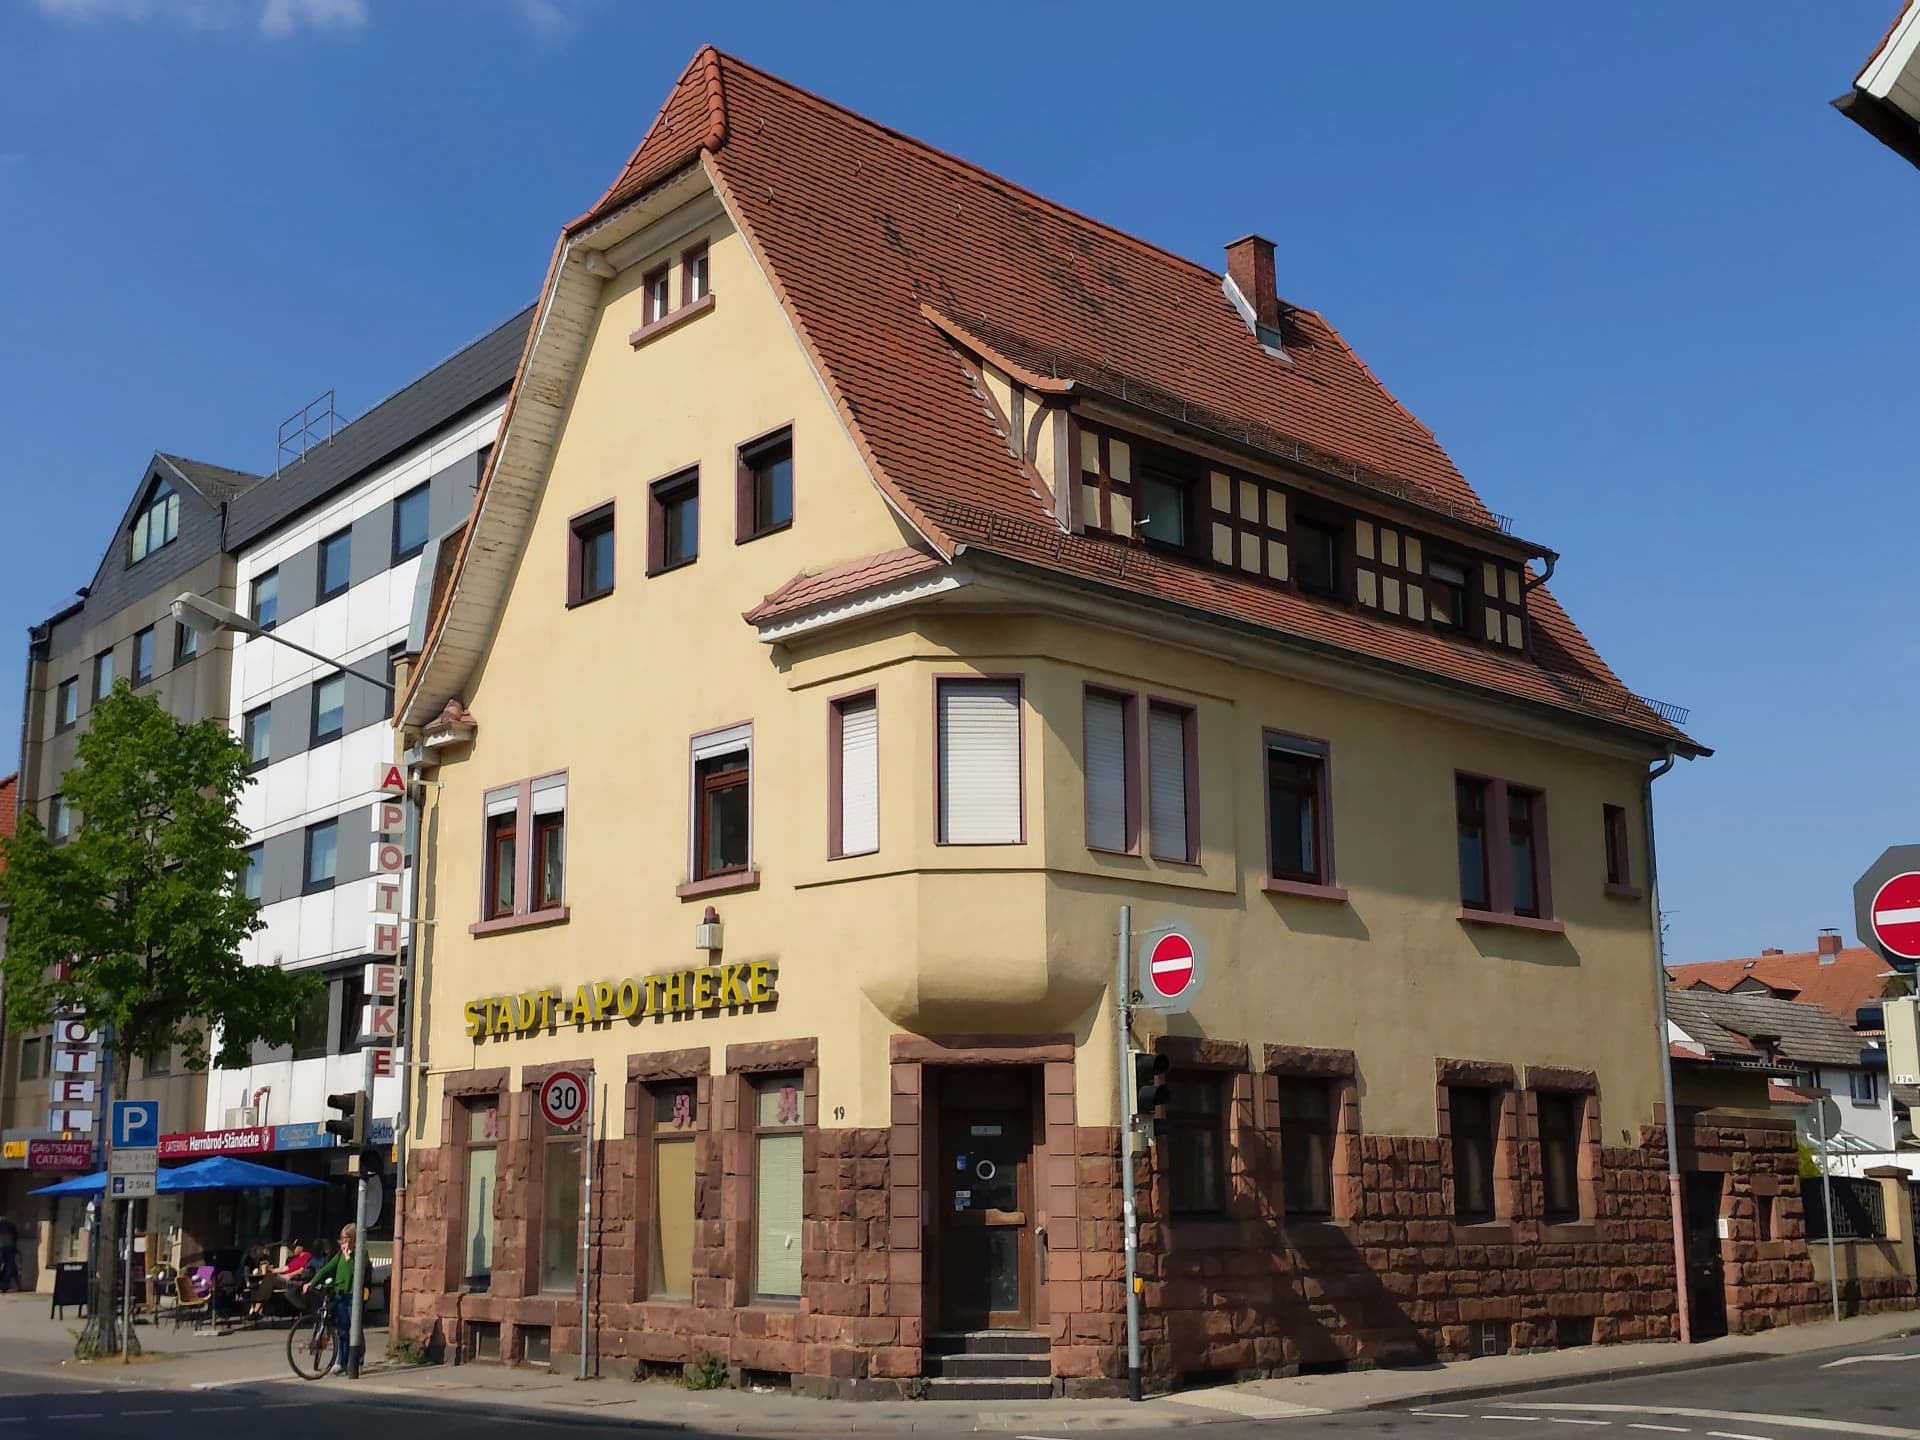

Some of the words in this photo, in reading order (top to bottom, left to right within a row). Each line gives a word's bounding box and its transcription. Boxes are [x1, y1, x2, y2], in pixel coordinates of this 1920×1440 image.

[372, 767, 405, 1075] APOTHEKE
[464, 960, 772, 1037] STADT-APOTHEKE
[63, 1001, 91, 1131] OTEL
[551, 1086, 577, 1110] 30
[123, 1107, 148, 1142] P
[833, 1106, 845, 1121] 19
[370, 1122, 393, 1139] lektro
[35, 1154, 83, 1165] CATERING
